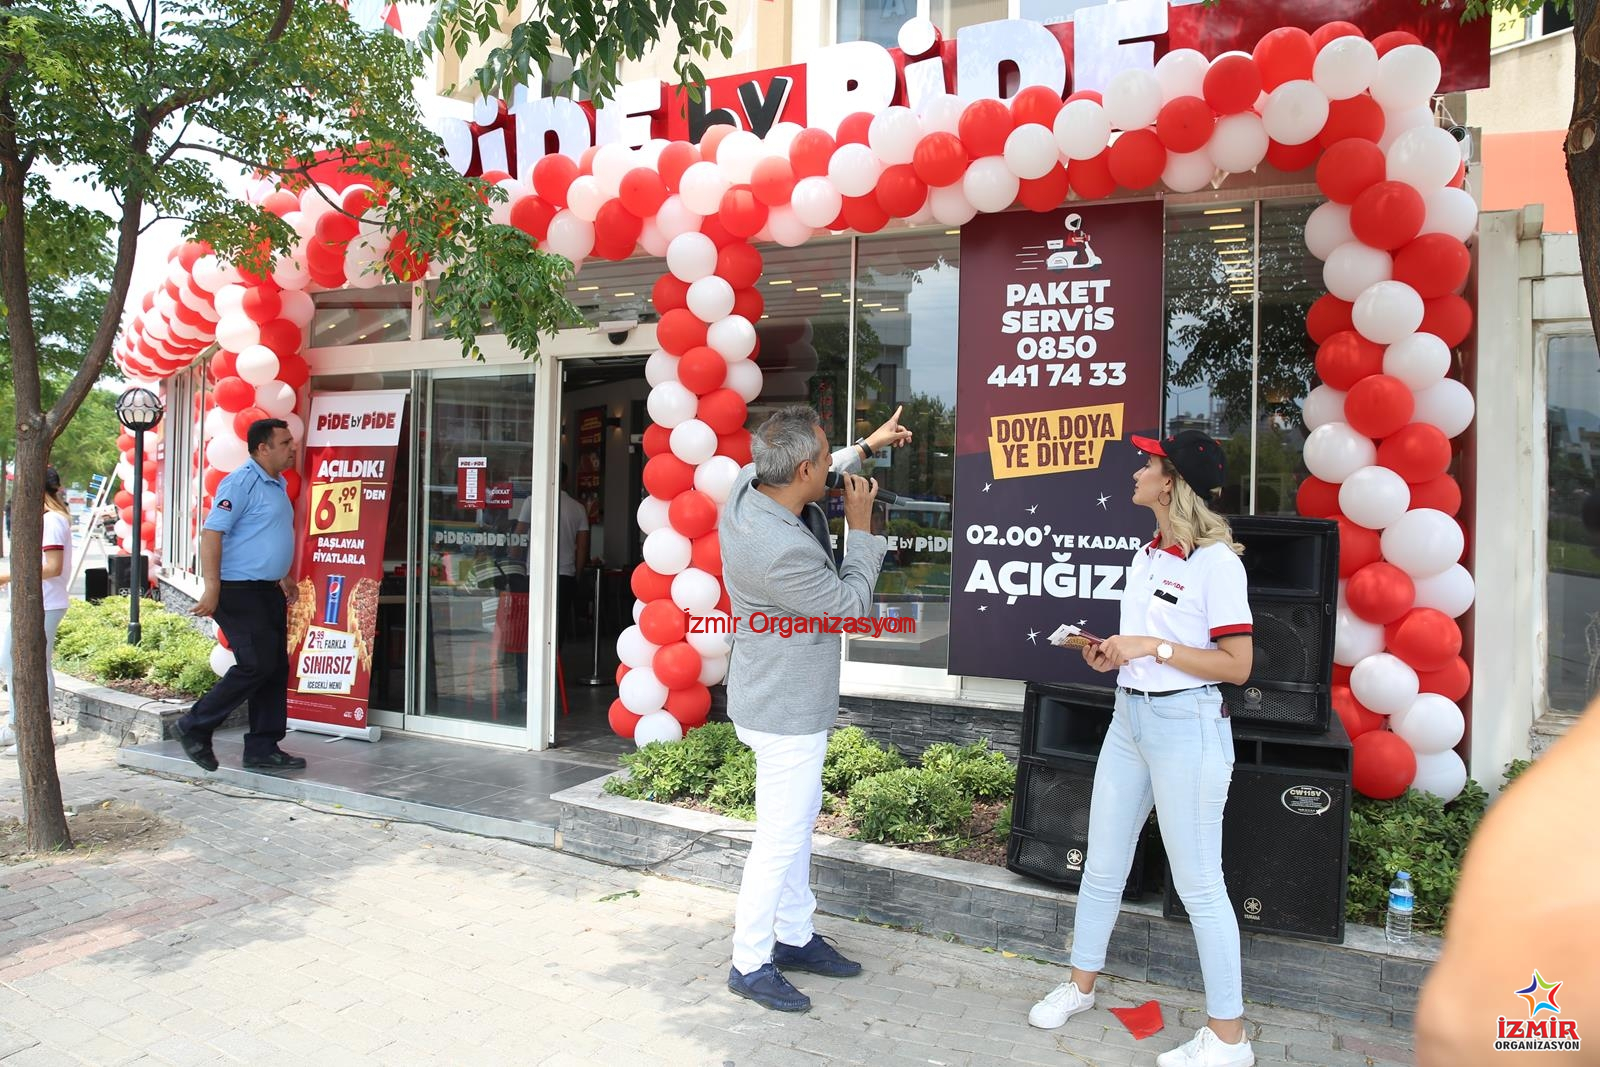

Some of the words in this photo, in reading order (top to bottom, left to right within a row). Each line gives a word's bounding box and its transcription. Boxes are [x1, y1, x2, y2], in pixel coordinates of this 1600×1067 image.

[1497, 19, 1516, 33] 27
[1006, 279, 1111, 307] PAKET
[1016, 335, 1098, 361] 0850
[987, 365, 1039, 388] 441
[1046, 363, 1082, 387] 74
[1088, 362, 1127, 386] 33
[1058, 413, 1115, 440] DOYA
[1002, 443, 1029, 469] YE
[1037, 436, 1095, 468] DİYE!
[317, 460, 385, 483] AÇILDIK!
[343, 503, 354, 513] TL
[317, 537, 365, 551] BAŞLAYAN
[900, 537, 914, 549] by
[1077, 535, 1141, 551] KADAR
[313, 549, 366, 565] FİYATLARLA
[964, 552, 1124, 605] AÇIĞIZ
[324, 639, 347, 649] FARKLA
